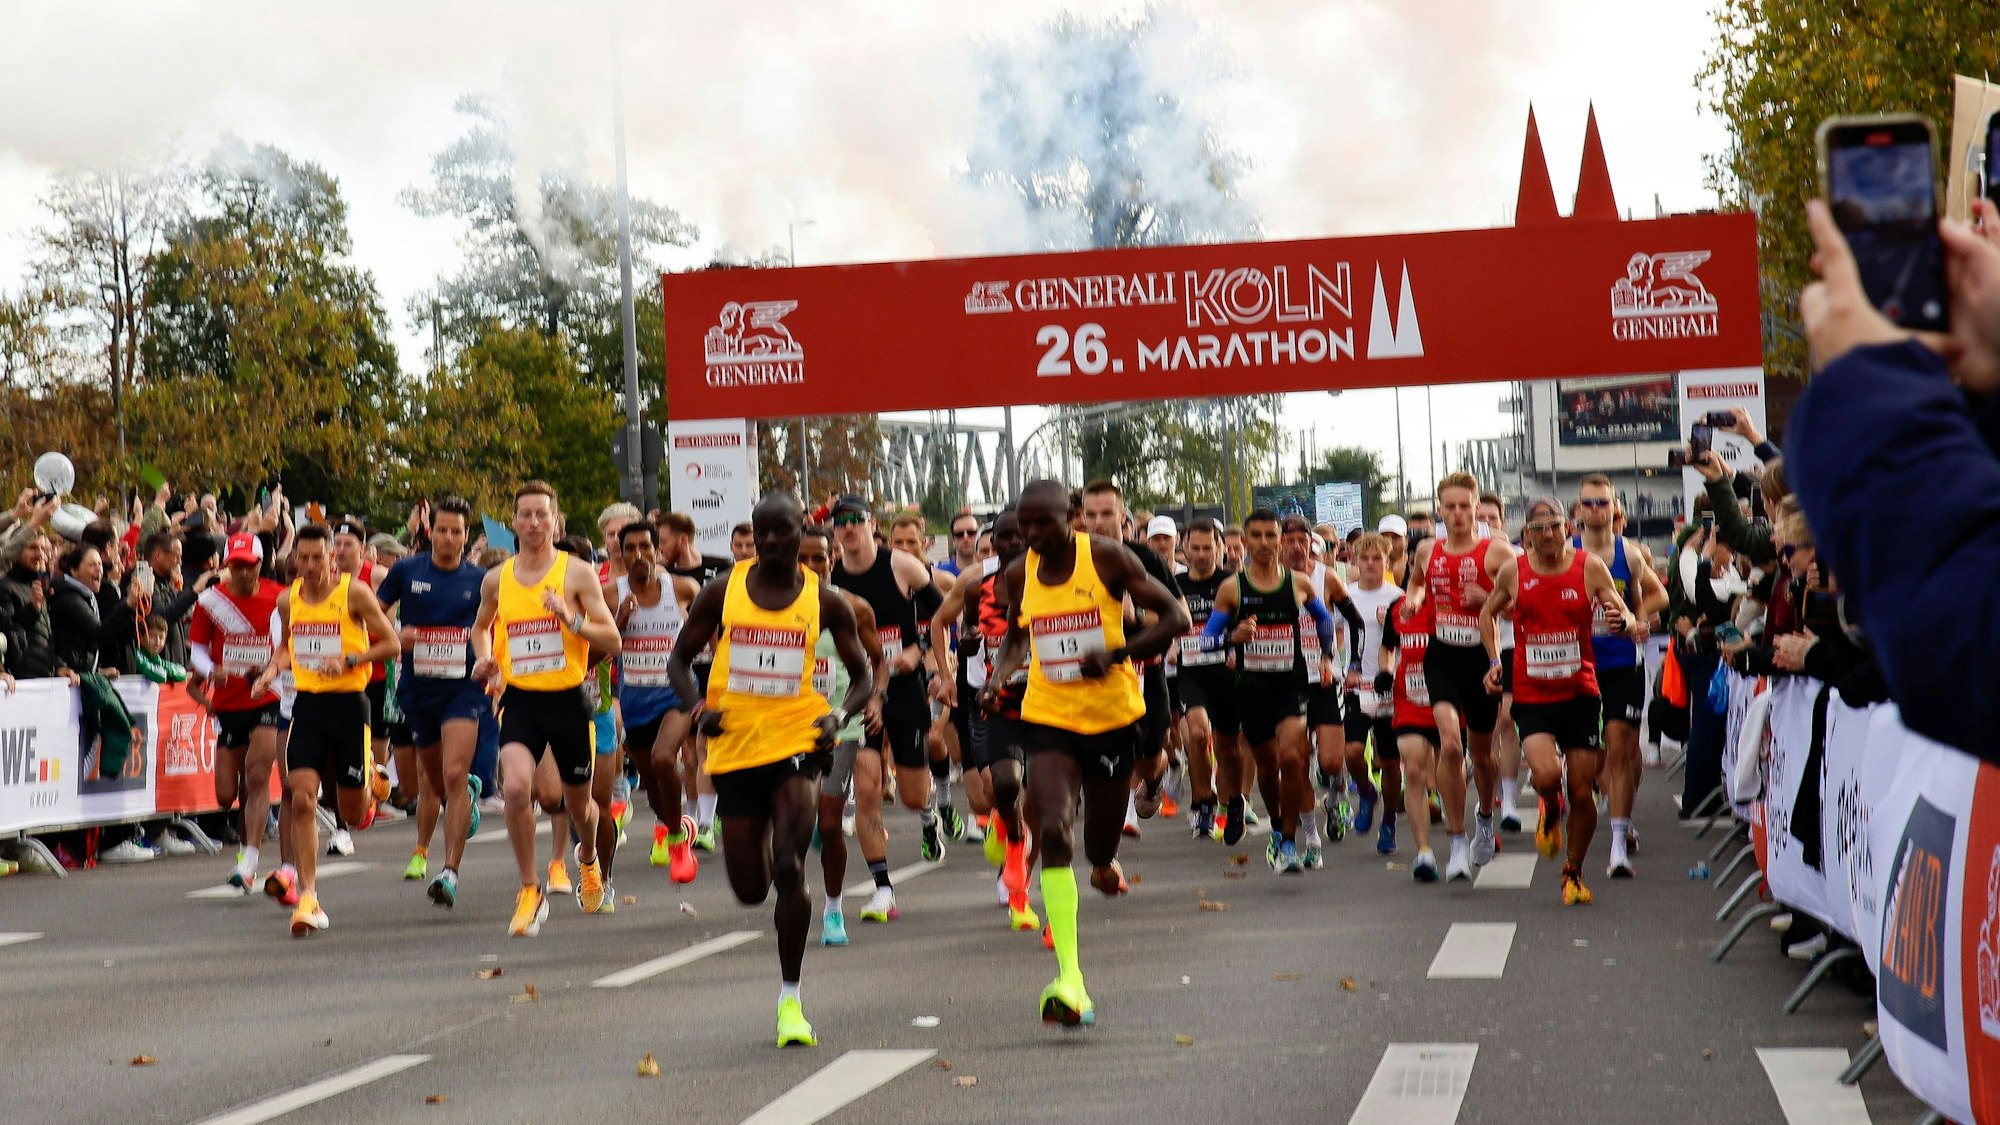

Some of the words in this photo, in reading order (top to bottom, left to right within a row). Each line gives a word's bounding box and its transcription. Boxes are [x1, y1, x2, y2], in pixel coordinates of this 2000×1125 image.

[1015, 271, 1177, 312] GENERALI
[1185, 261, 1353, 328] KÖLN
[1612, 315, 1719, 342] GENERALI
[1036, 322, 1125, 378] 26.
[1138, 327, 1355, 372] MARATHON
[706, 363, 805, 388] GENERALI
[1704, 384, 1757, 398] GENERALI
[690, 434, 738, 449] GENERALI
[526, 638, 541, 653] 15
[29, 790, 61, 809] GROUP
